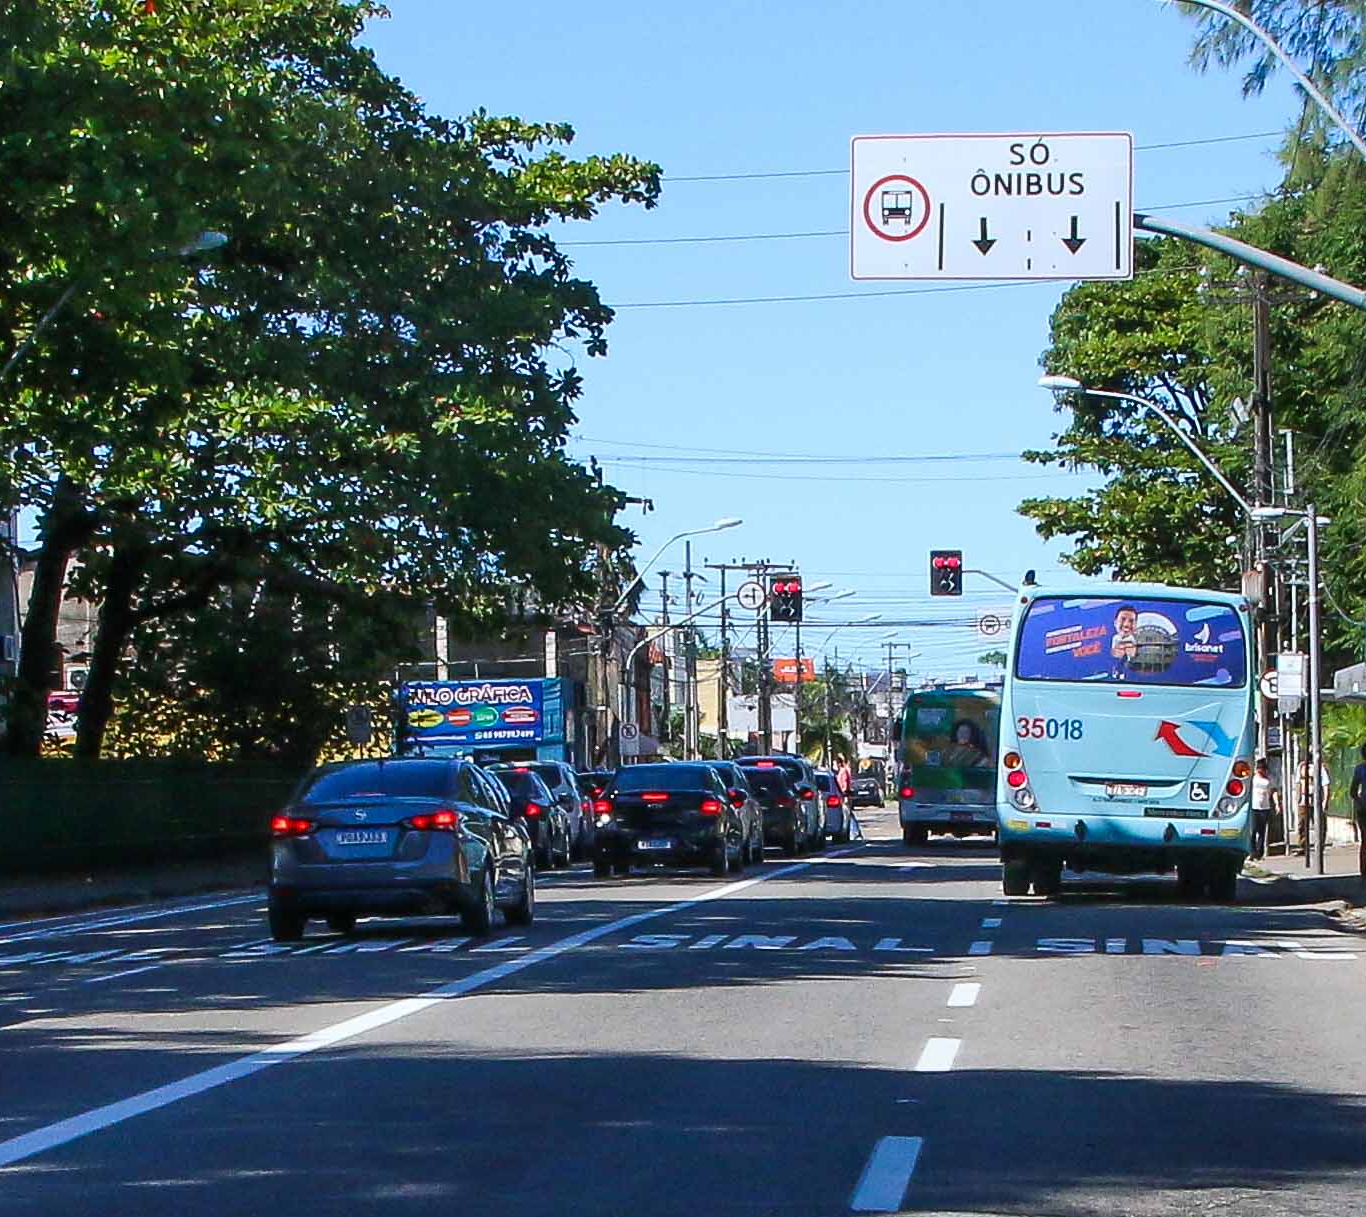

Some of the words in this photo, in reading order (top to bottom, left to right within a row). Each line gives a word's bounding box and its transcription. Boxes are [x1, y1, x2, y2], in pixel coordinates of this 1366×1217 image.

[1009, 137, 1050, 165] SÓ
[970, 169, 1085, 196] ÔNIBUS
[1184, 642, 1225, 654] brisanet
[454, 684, 533, 706] GRÁFICA
[1017, 717, 1083, 740] 35018
[619, 934, 934, 952] SINAL
